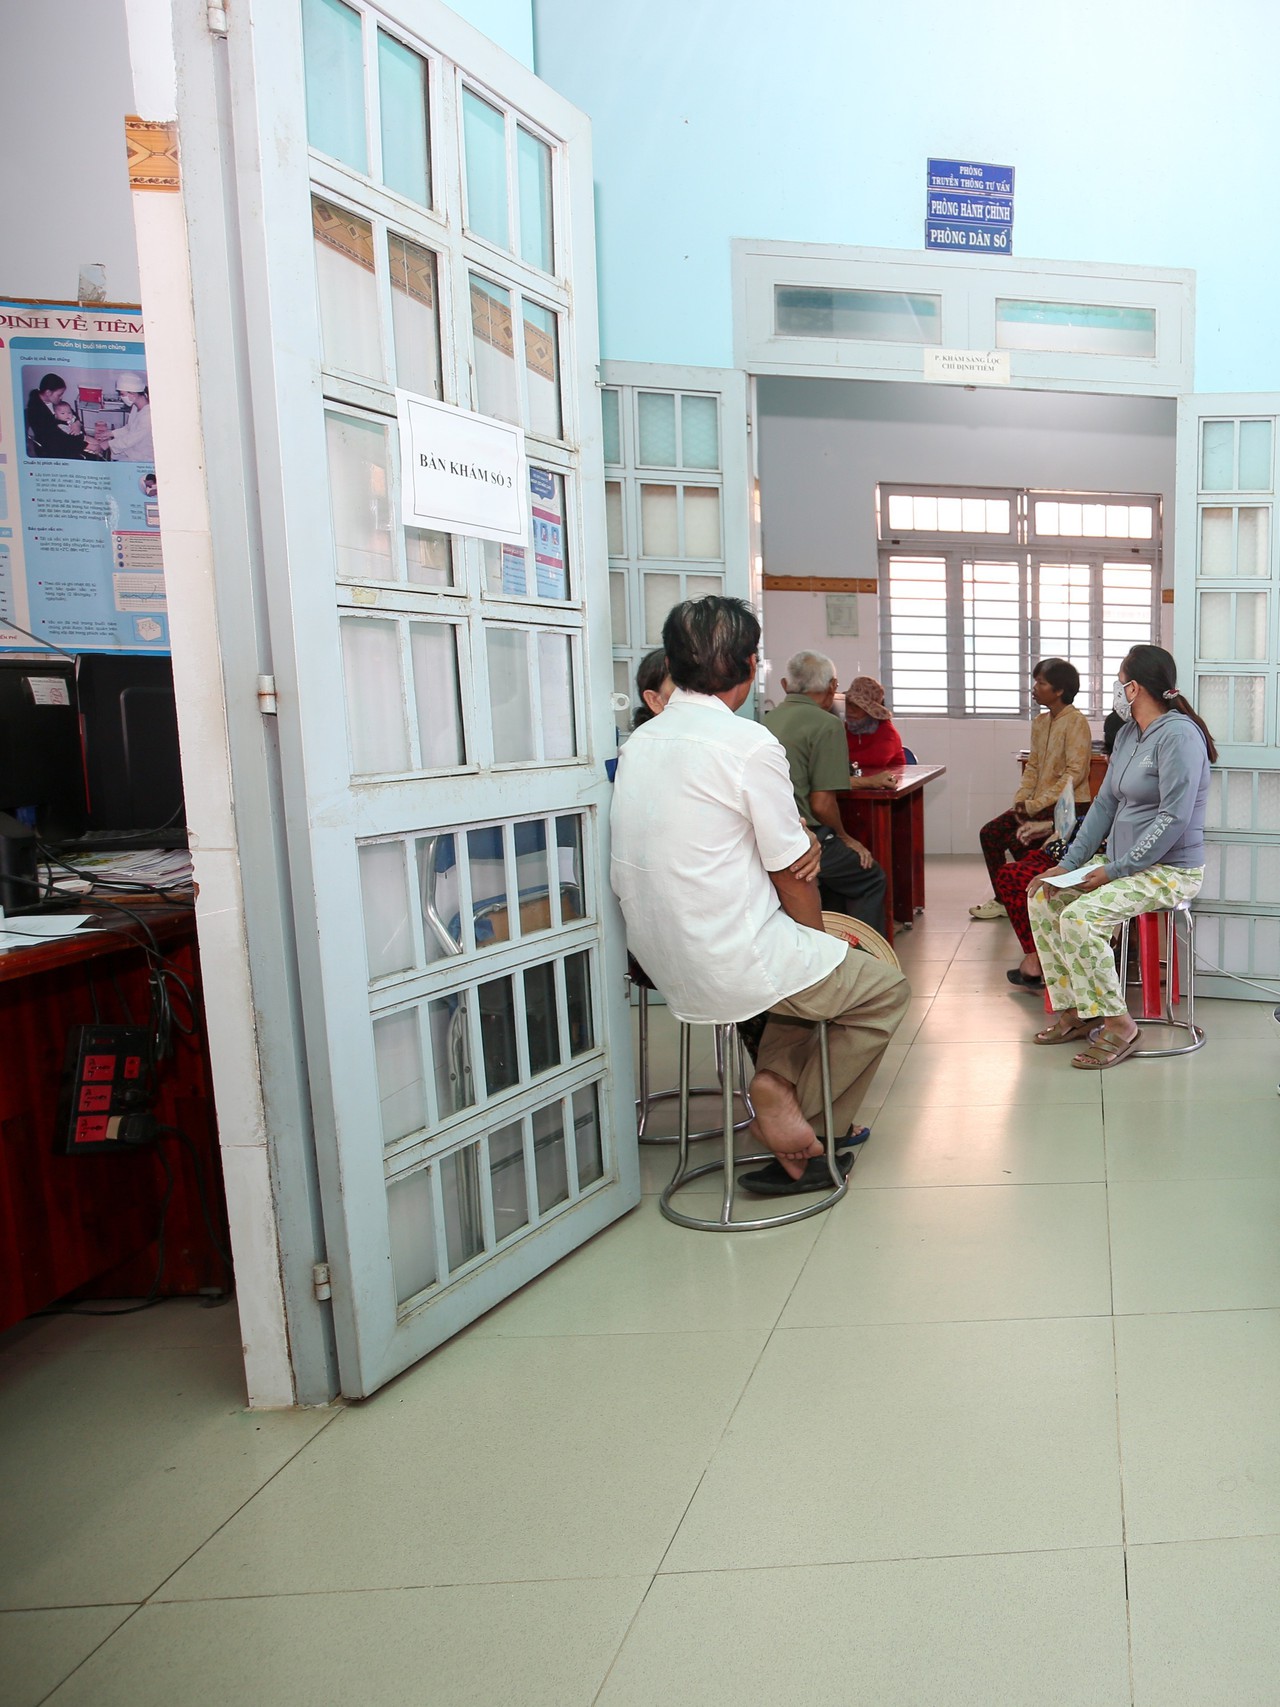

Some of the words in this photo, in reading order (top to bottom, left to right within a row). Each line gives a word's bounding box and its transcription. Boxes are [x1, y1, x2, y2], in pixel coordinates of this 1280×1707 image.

[959, 165, 983, 177] PHÒNG
[960, 177, 984, 189] THÔNG
[985, 181, 995, 191] TƯ
[996, 180, 1011, 192] VẤN
[931, 198, 959, 216] PHÒNG
[960, 200, 984, 218] HÀNH
[985, 202, 1011, 221] CHÍNH
[930, 227, 966, 245] PHÒNG
[969, 229, 991, 246] DÂN
[993, 229, 1007, 248] SỐ
[56, 315, 88, 331] VỀ
[420, 452, 446, 471] BÀN
[450, 461, 488, 482] KHÁM
[506, 476, 512, 488] 3
